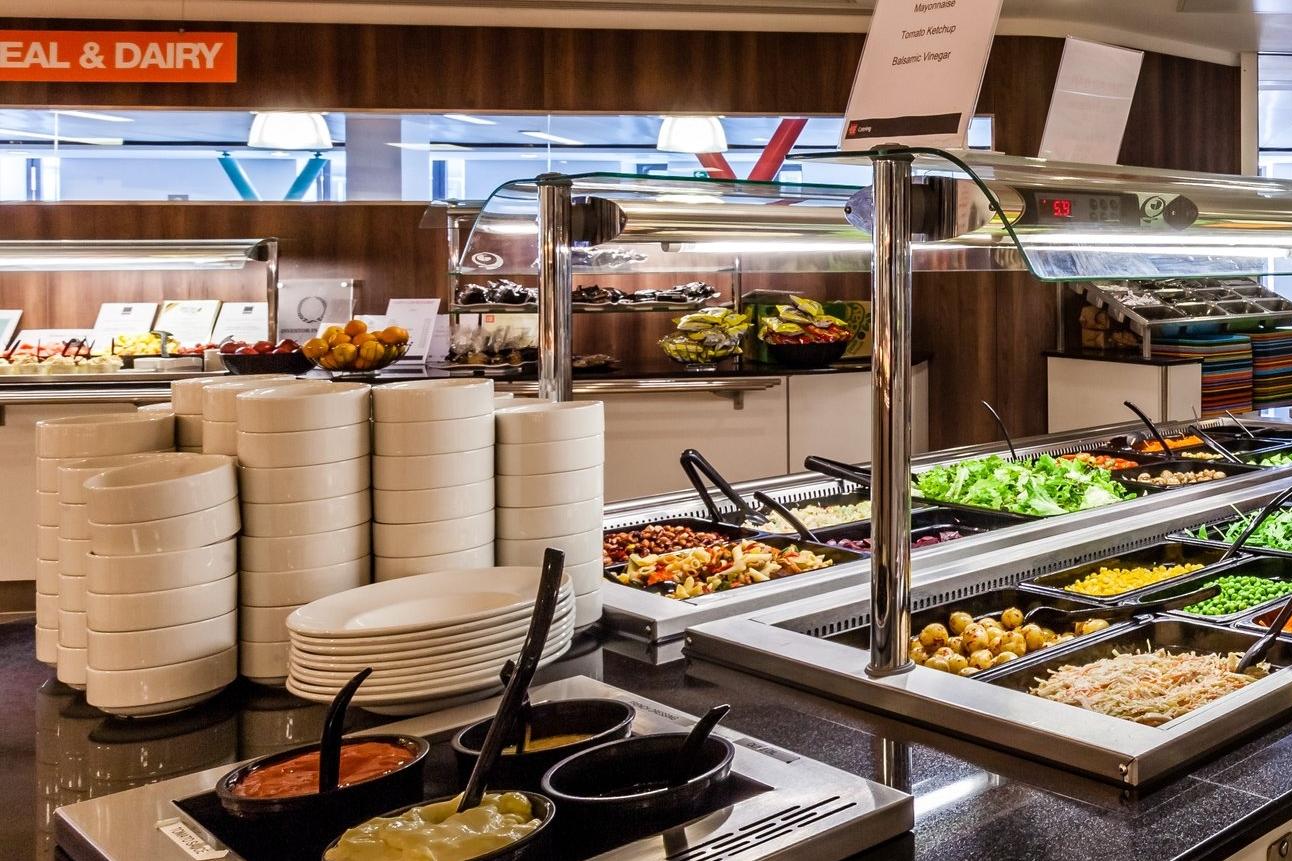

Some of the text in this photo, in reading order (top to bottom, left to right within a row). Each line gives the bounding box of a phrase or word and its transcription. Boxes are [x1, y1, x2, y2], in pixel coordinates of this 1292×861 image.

[914, 0, 956, 13] Mayonnaise
[901, 25, 956, 39] Tomato Ketchup
[79, 41, 107, 69] &
[115, 42, 224, 69] DAIRY
[892, 52, 951, 66] Balsamic Vinegar
